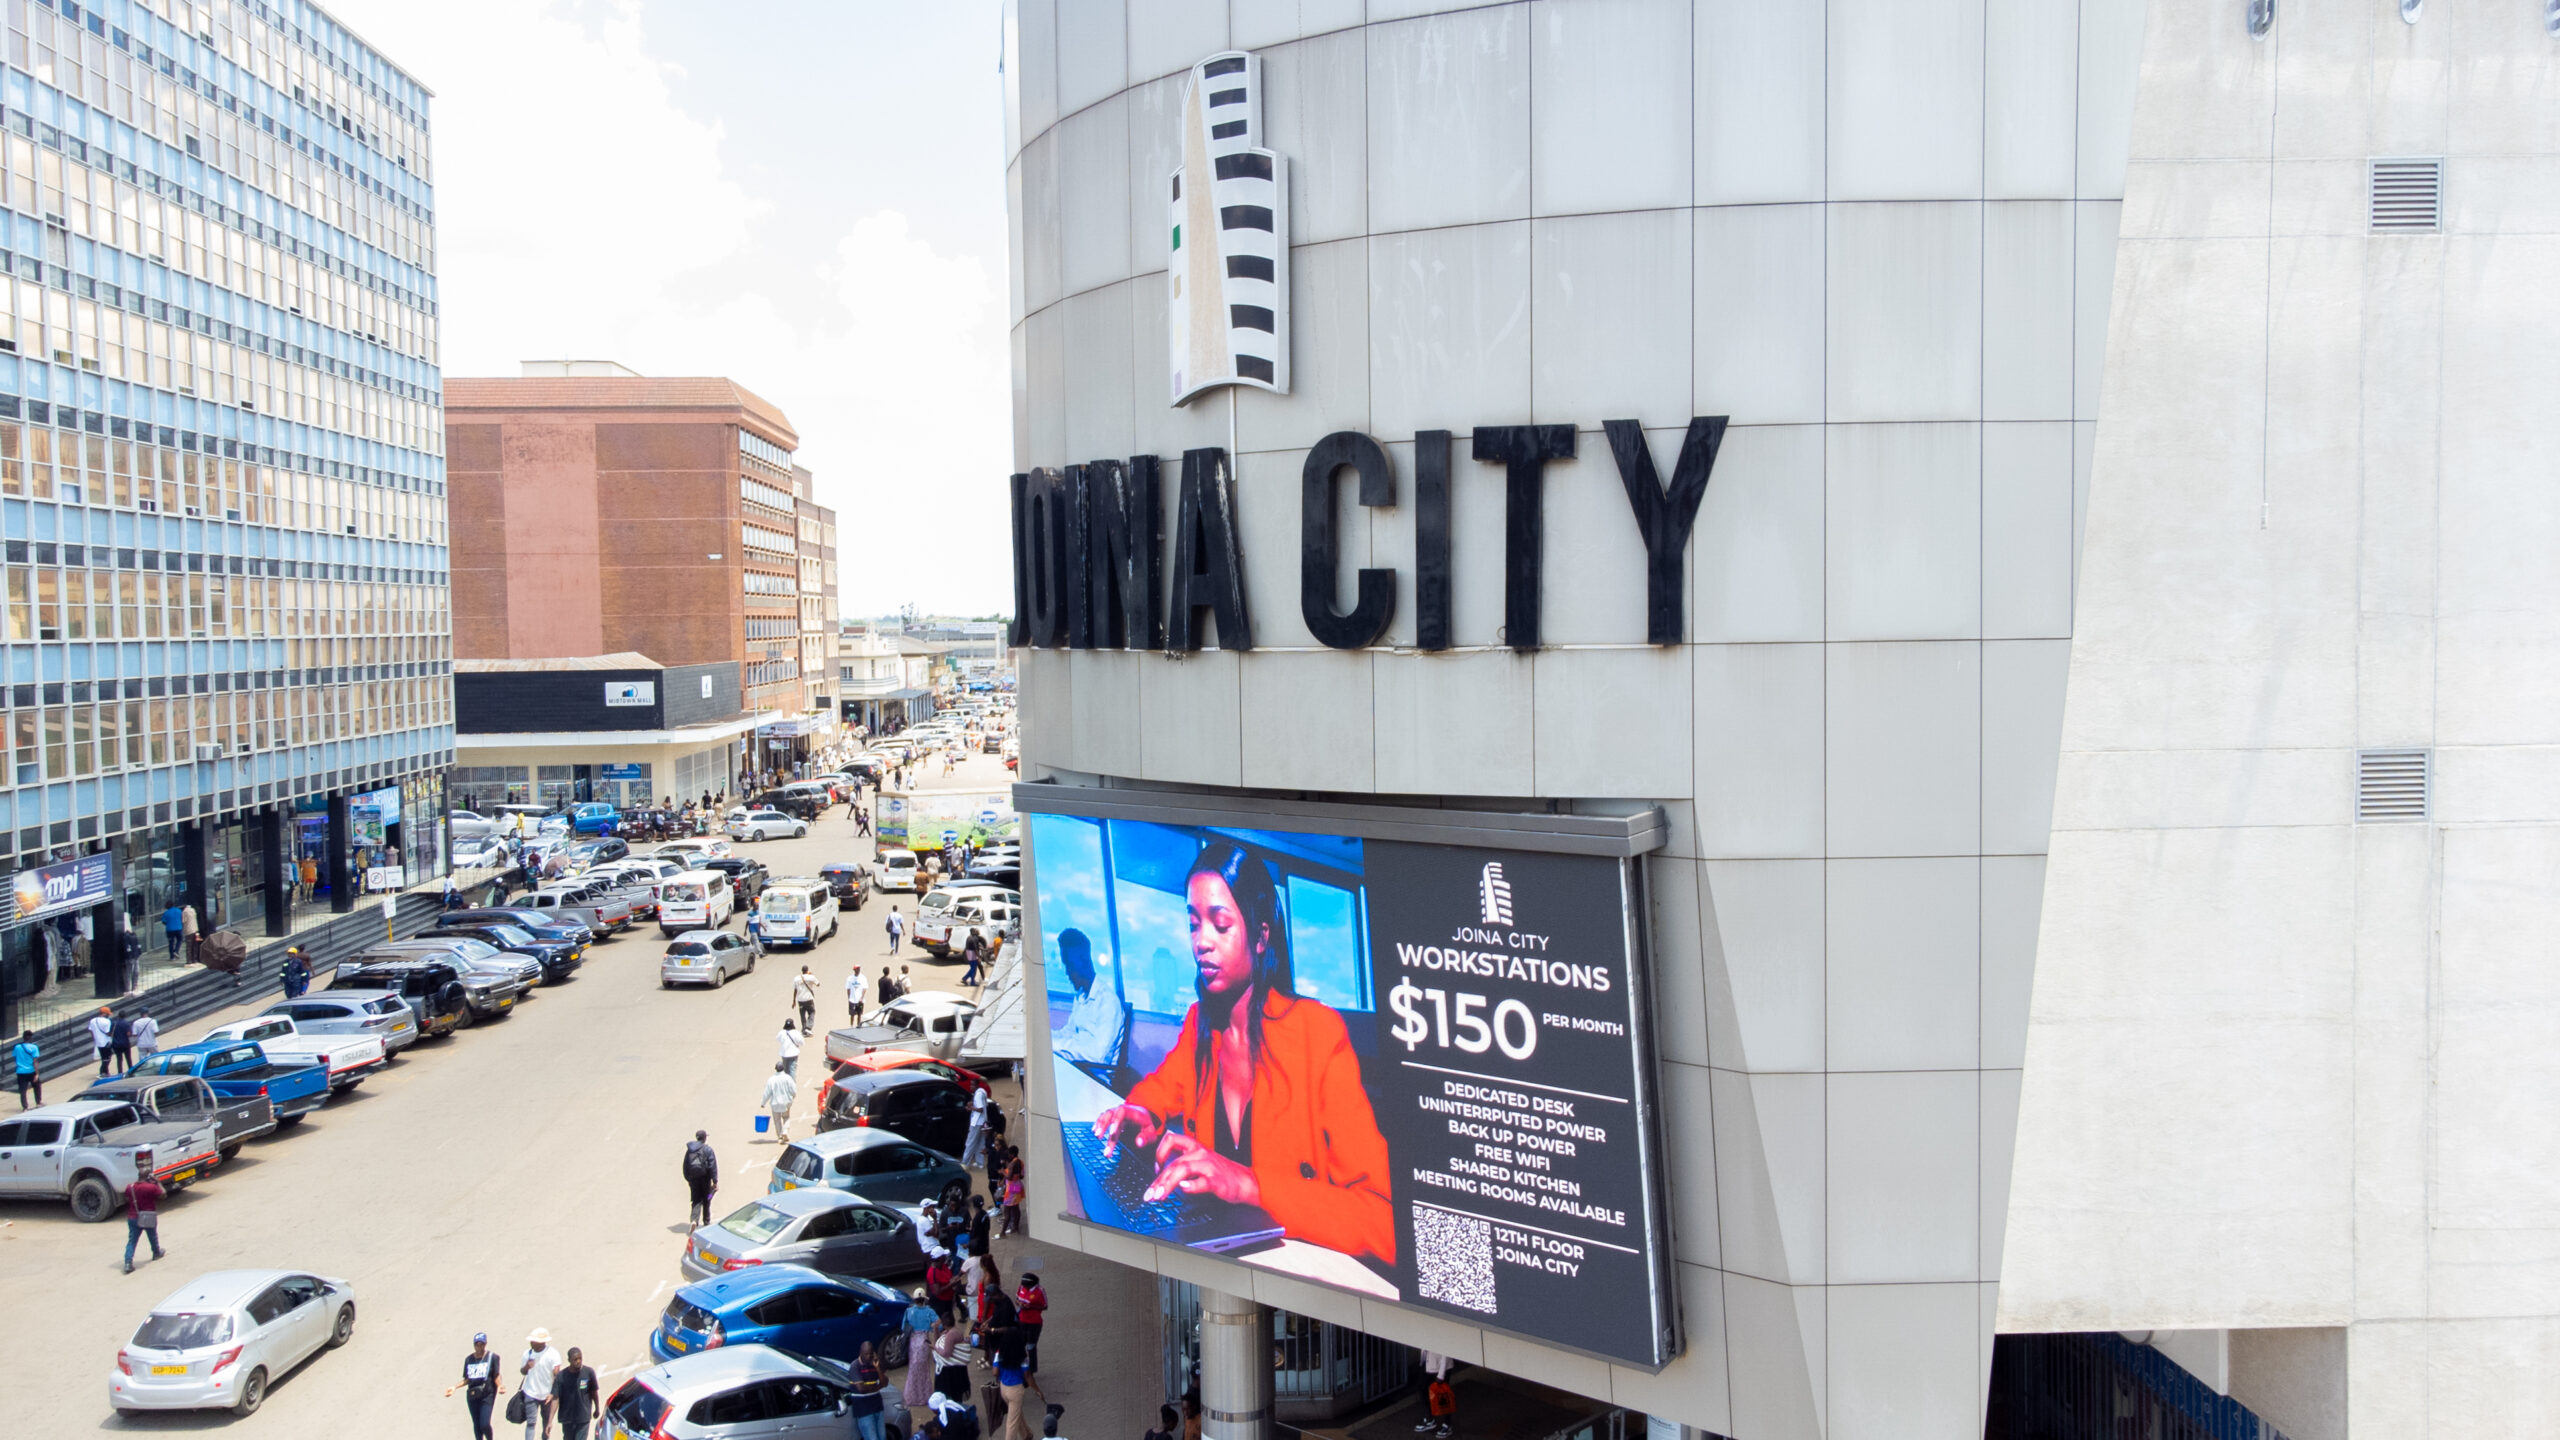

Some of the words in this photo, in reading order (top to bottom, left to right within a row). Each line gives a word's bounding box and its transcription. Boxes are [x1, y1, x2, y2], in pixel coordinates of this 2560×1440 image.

[1007, 447, 1251, 651] JOINA
[1301, 415, 1729, 651] CITY
[637, 696, 652, 704] MALL
[1452, 927, 1503, 946] JOINA
[1508, 932, 1549, 951] CITY
[1396, 942, 1611, 992] WORKSTATIONS
[1389, 976, 1537, 1060] $150
[1543, 1013, 1570, 1028] PER
[1572, 1017, 1624, 1036] MONTH
[342, 1047, 372, 1063] ISUZU
[1444, 1081, 1529, 1109] DEDICATED
[1532, 1097, 1575, 1117] DESK
[1418, 1095, 1542, 1131] UNINTERRPUTED
[1546, 1118, 1606, 1143] POWER
[1449, 1120, 1489, 1139] BACK
[1492, 1128, 1514, 1143] UP
[1517, 1133, 1576, 1156] POWER
[1475, 1144, 1513, 1163] FREE
[1515, 1151, 1551, 1170] WIFI
[1450, 1158, 1511, 1181] SHARED
[1514, 1170, 1581, 1196] KITCHEN
[1414, 1168, 1478, 1193] MEETING
[1481, 1182, 1537, 1207] ROOMS
[1539, 1194, 1626, 1226] AVAILABLE
[1494, 1227, 1528, 1248] 12TH
[1532, 1235, 1585, 1260] FLOOR
[1496, 1247, 1543, 1270] JOINA
[1545, 1258, 1579, 1277] CITY
